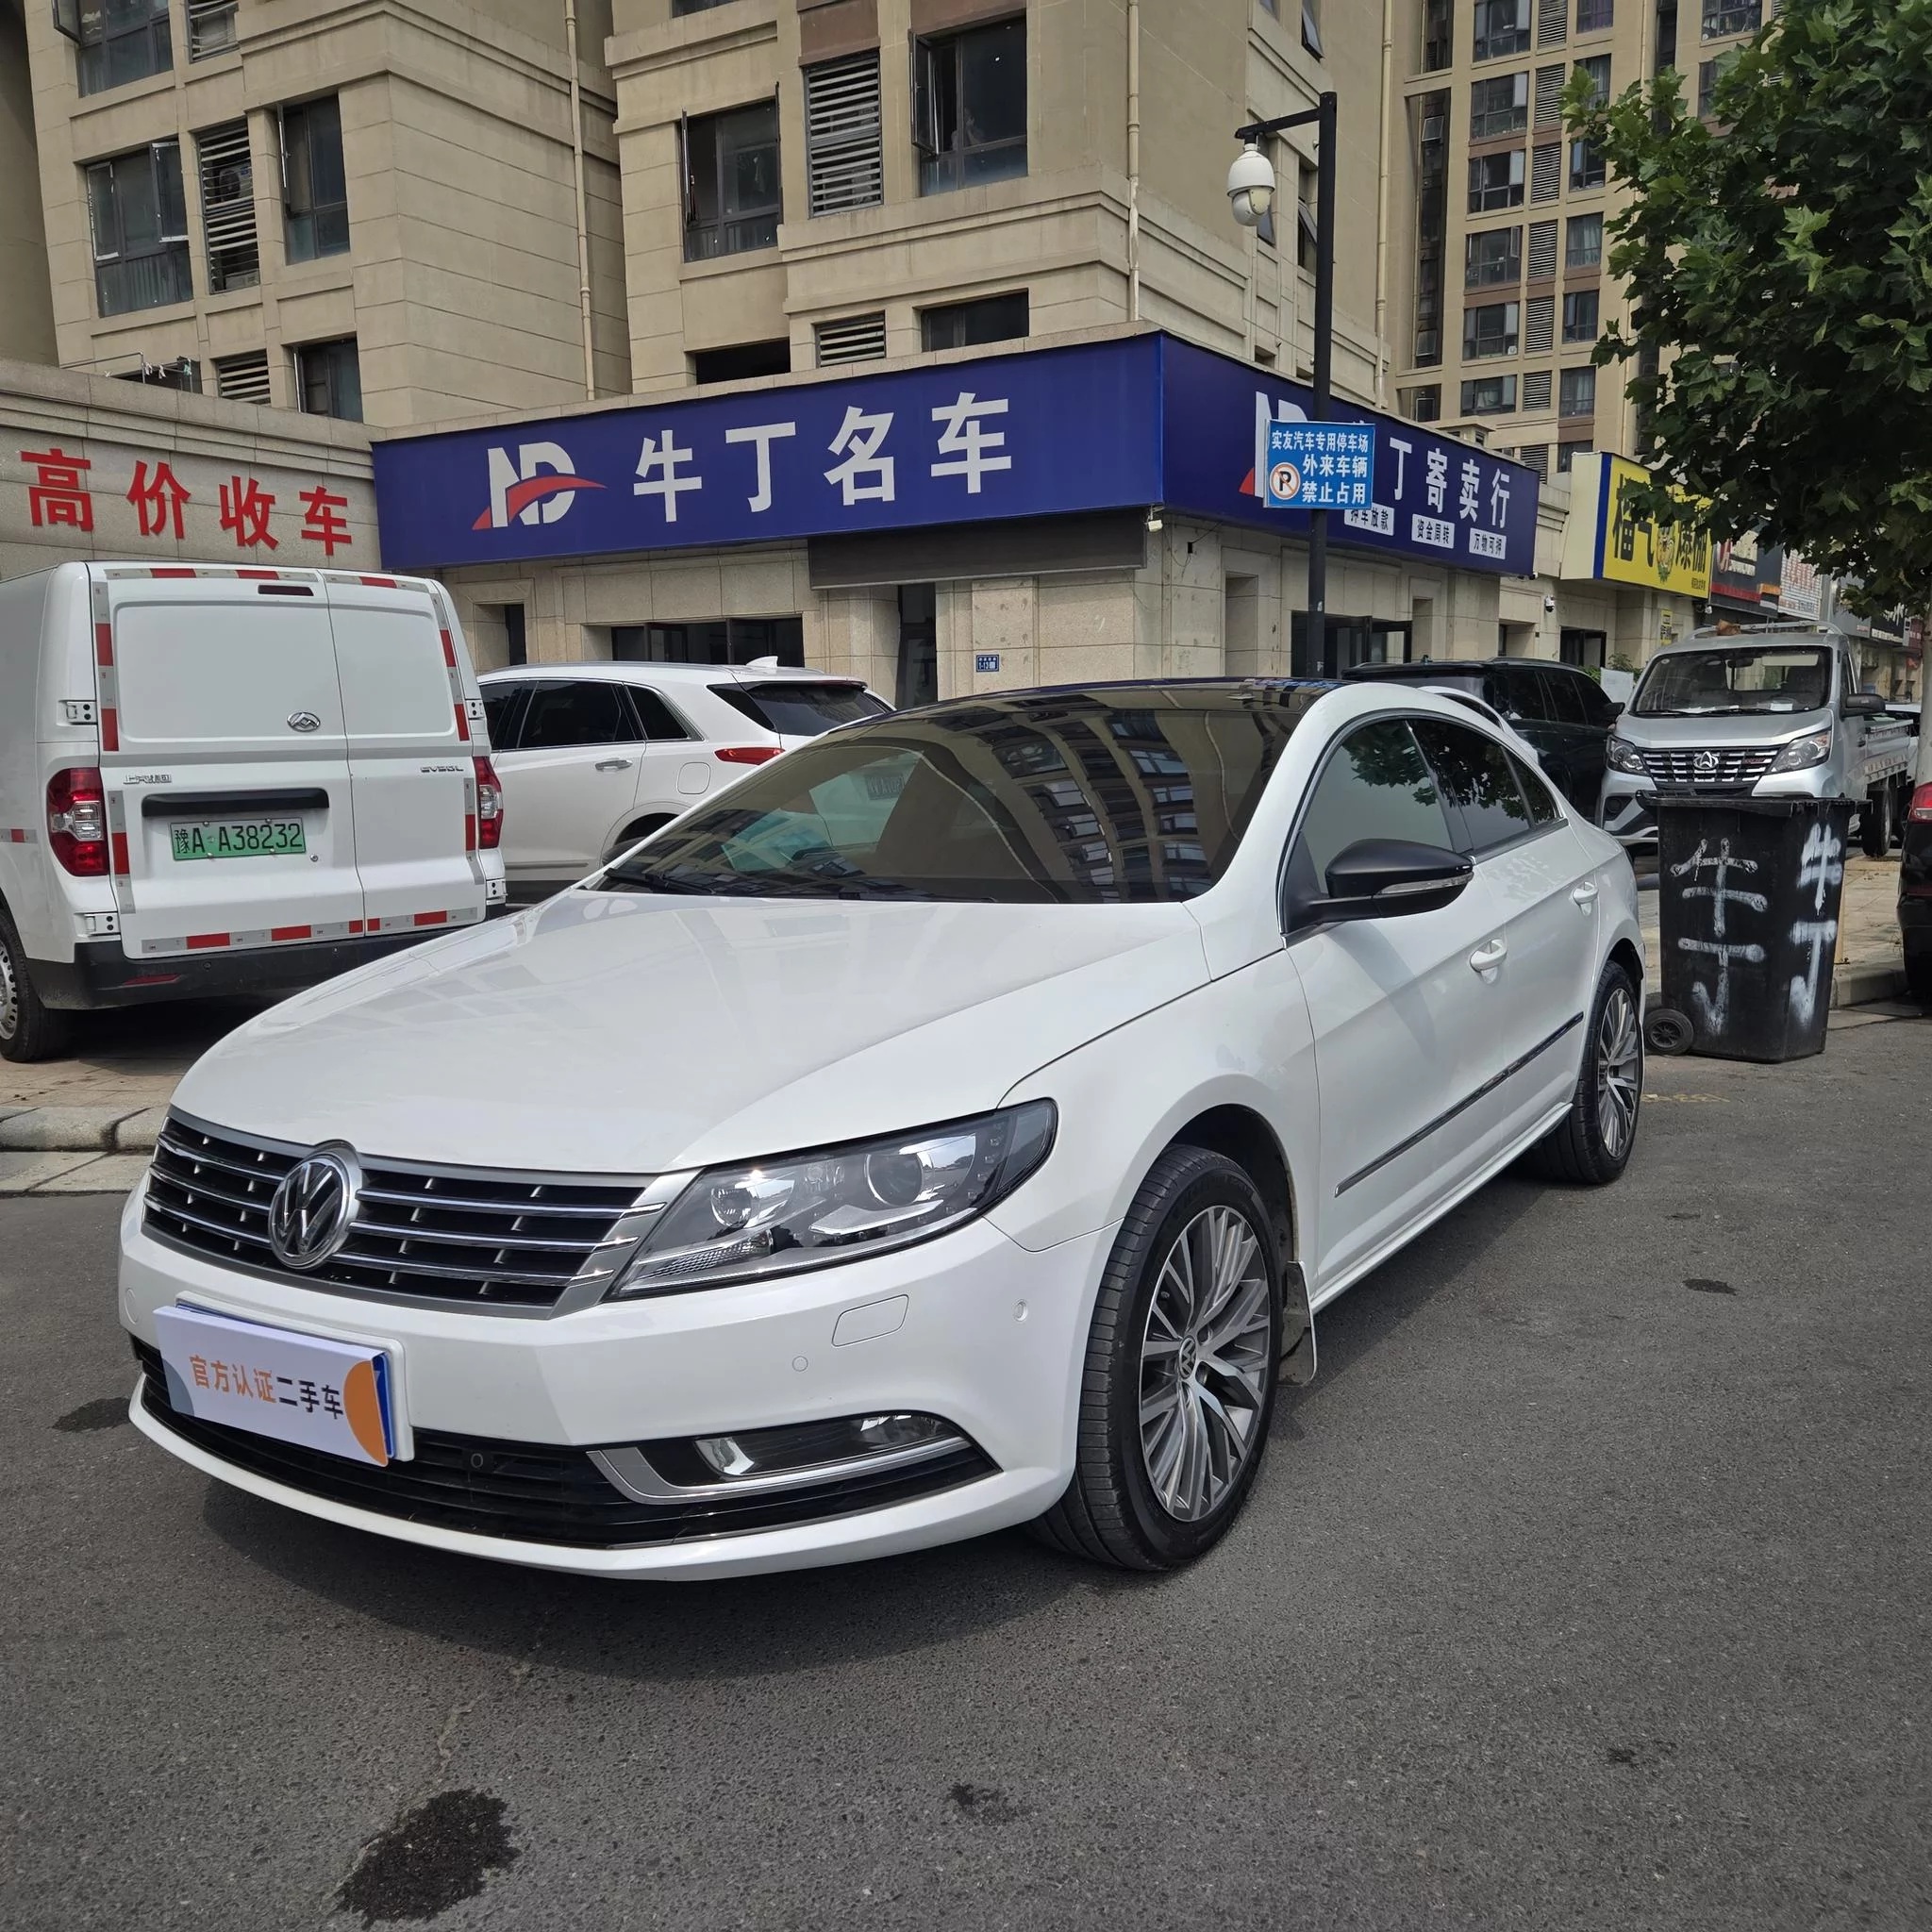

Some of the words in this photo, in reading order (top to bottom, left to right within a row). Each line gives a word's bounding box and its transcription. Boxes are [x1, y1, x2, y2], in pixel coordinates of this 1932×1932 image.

[634, 391, 1012, 523] 牛丁名车
[1271, 429, 1369, 453] 实友汽车专用停车场
[1302, 454, 1368, 478] 外来车辆
[1353, 421, 1510, 529] 丁寄卖行
[20, 448, 353, 557] 高价收车
[1302, 480, 1366, 505] 禁止占用
[1417, 518, 1450, 544] 资金周转
[189, 1354, 344, 1420] 官方认证二手车
